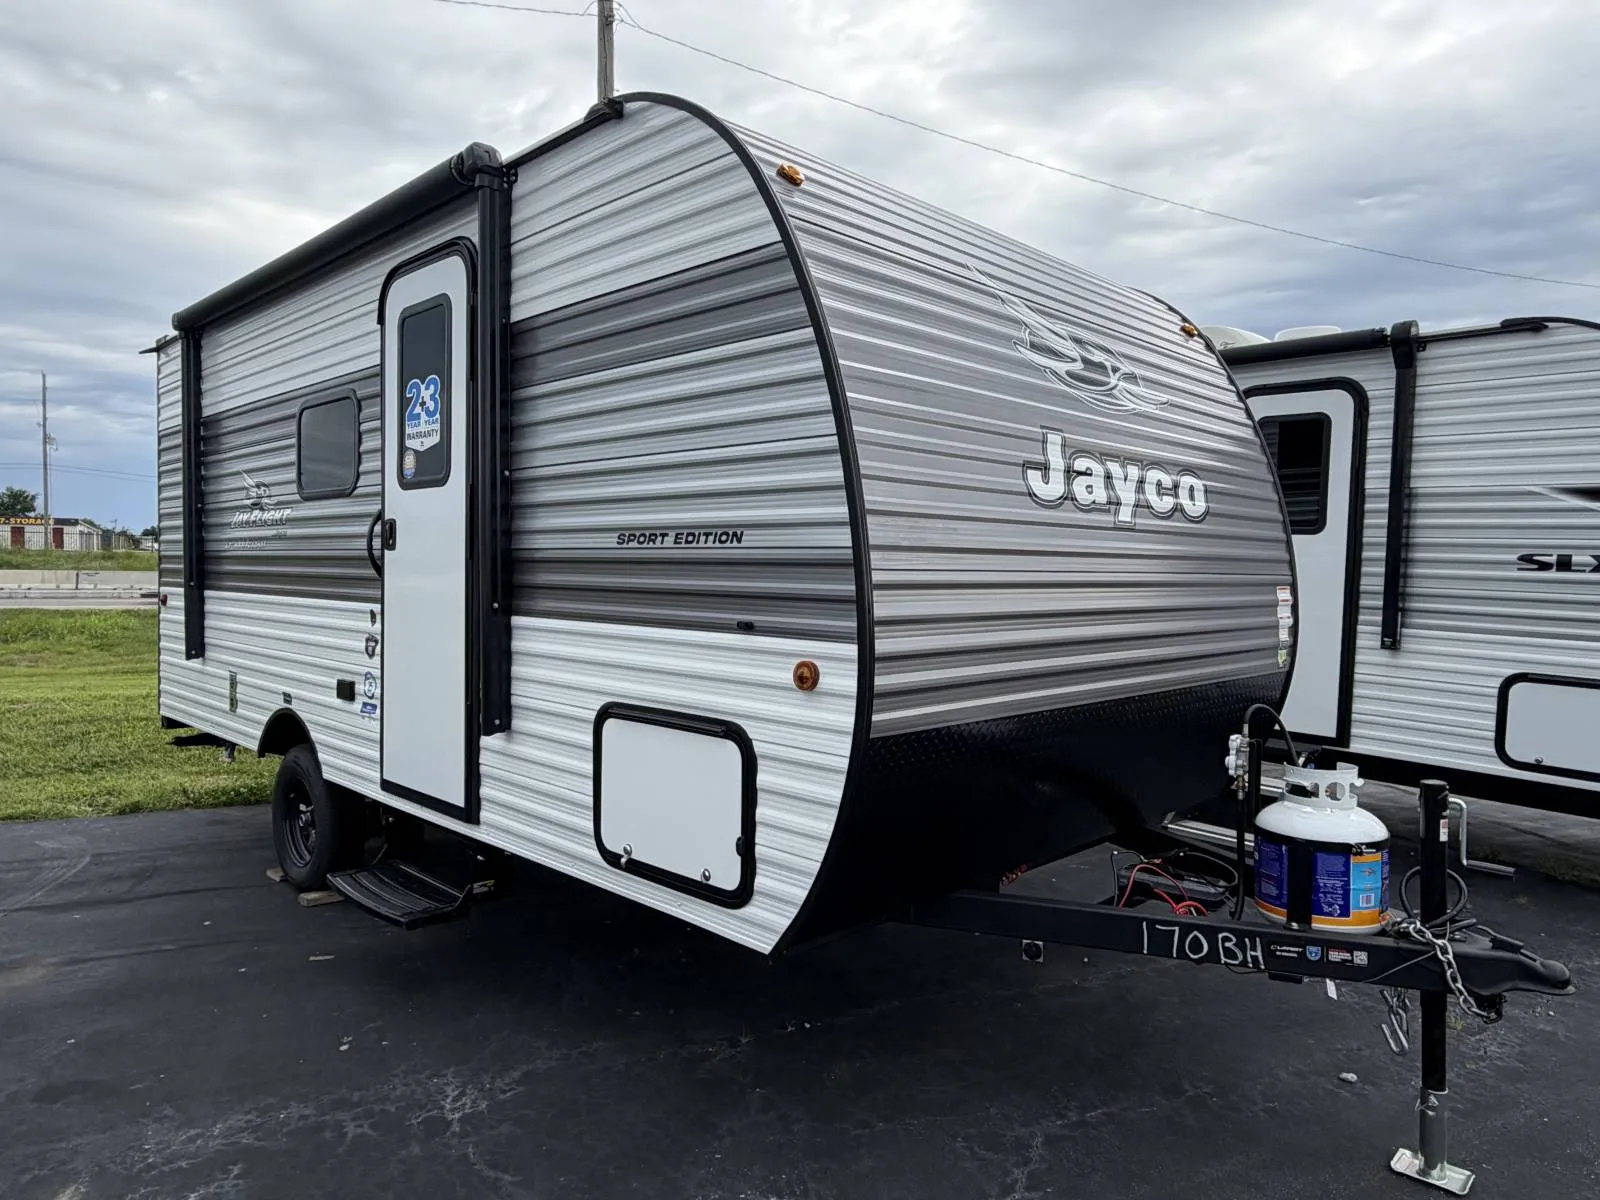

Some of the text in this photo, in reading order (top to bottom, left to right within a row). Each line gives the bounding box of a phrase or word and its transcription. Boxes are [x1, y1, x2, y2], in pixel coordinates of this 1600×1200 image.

[407, 418, 439, 430] YEAR YEAR
[407, 428, 439, 441] WARRANTY
[1024, 428, 1208, 527] Jayco
[616, 530, 744, 546] SPORT EDITION
